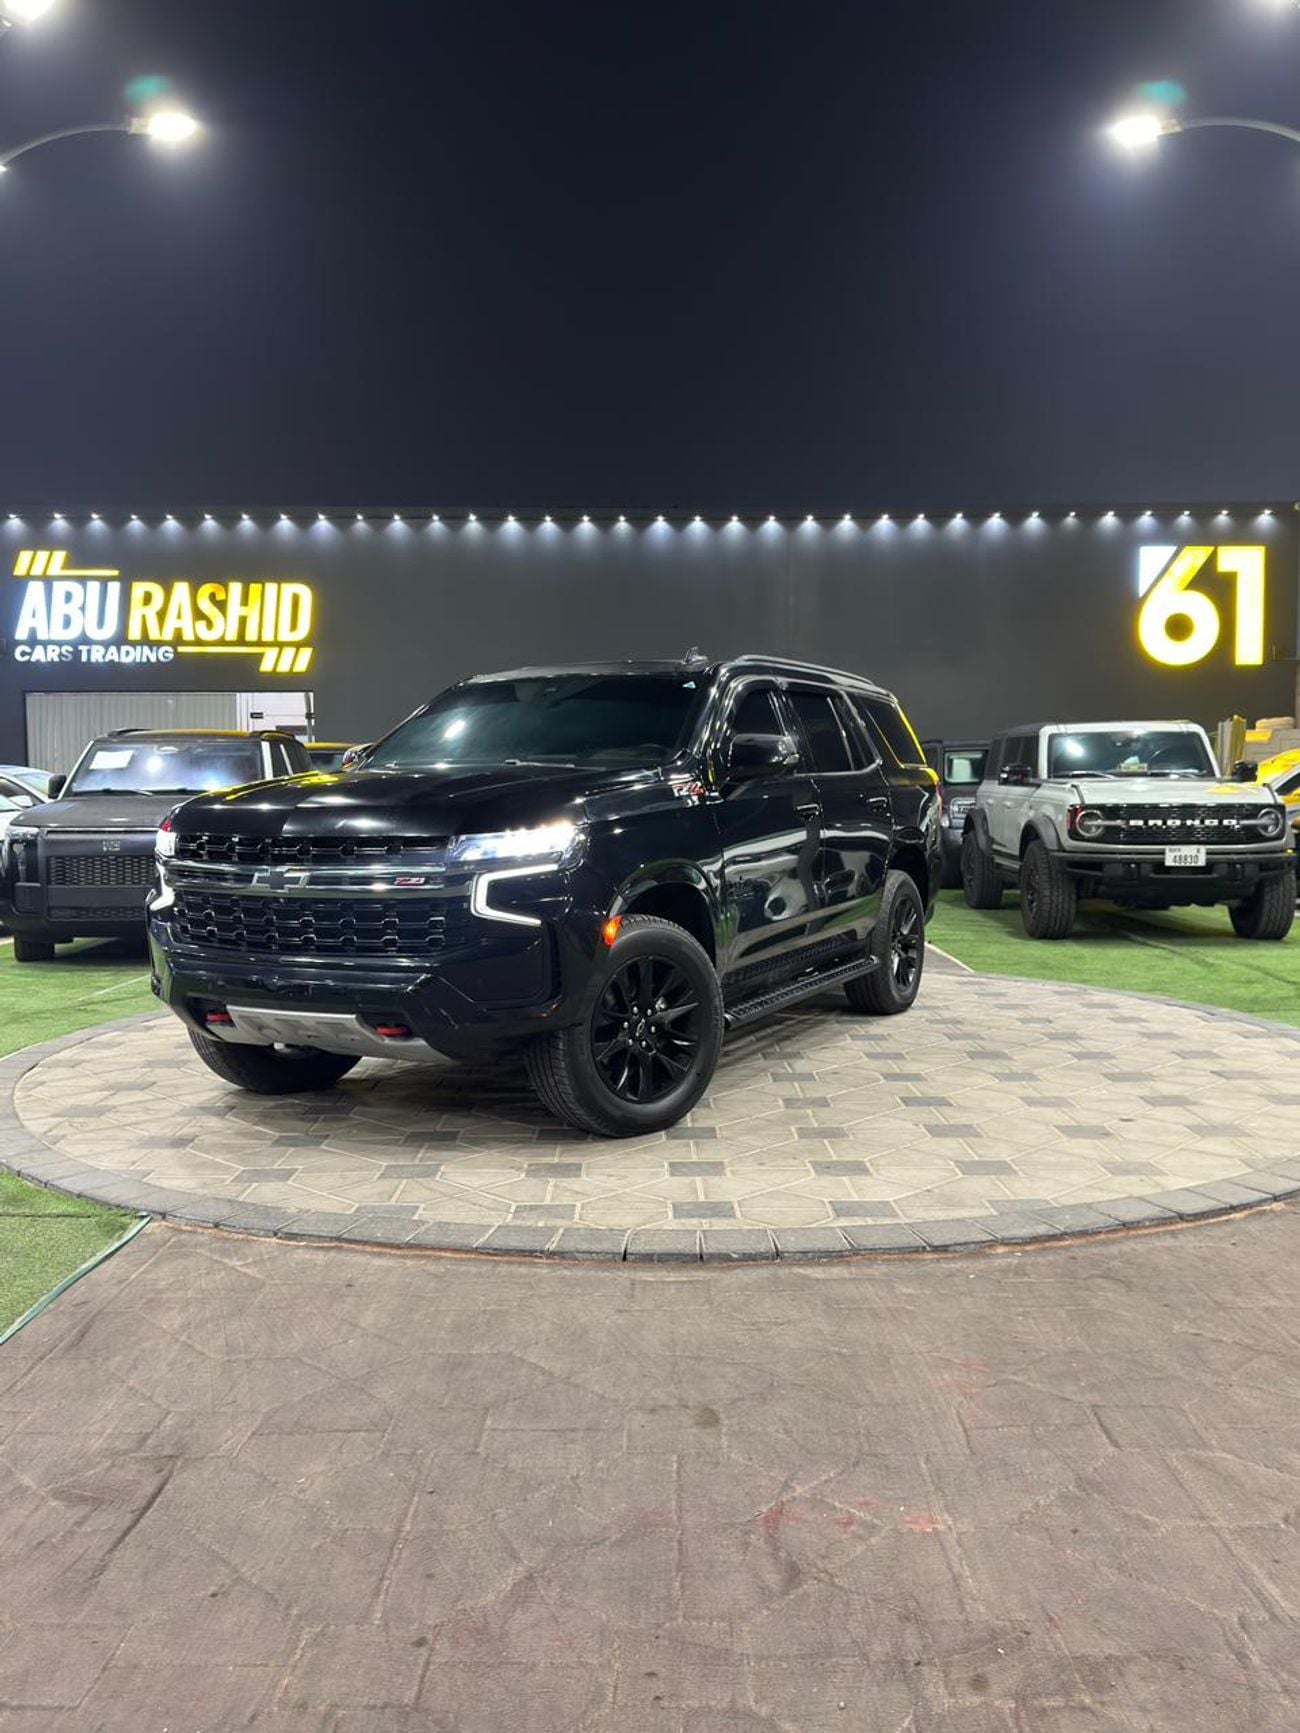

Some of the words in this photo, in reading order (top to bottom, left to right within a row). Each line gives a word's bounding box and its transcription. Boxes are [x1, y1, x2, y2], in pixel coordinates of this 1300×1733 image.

[14, 581, 121, 641] ABU
[127, 581, 313, 641] RASHID
[1138, 546, 1266, 666] 61
[14, 645, 73, 663] CARS
[78, 645, 175, 663] TRADING
